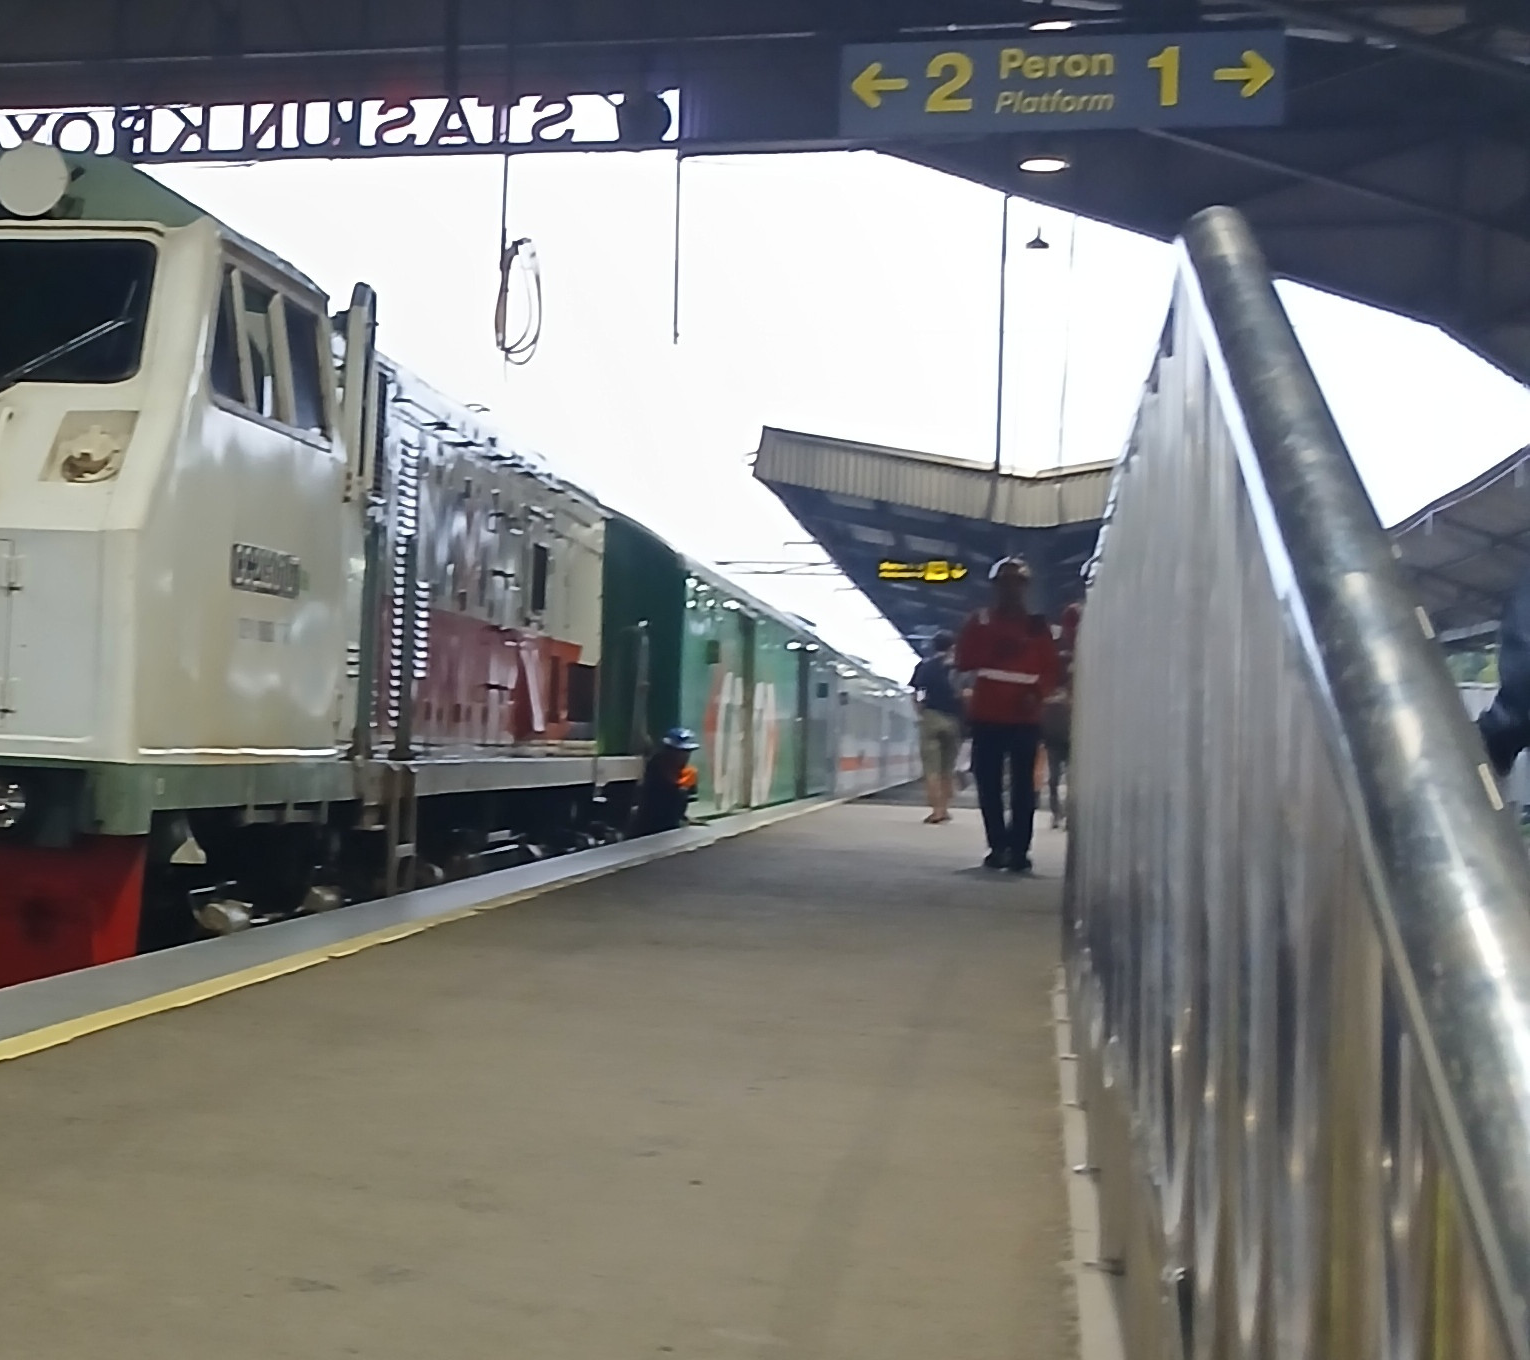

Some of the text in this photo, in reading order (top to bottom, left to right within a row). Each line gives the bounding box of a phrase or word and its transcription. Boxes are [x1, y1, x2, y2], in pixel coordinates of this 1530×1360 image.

[924, 51, 974, 113] 2
[999, 48, 1116, 80] Peron
[1147, 45, 1181, 107] 1
[994, 88, 1116, 115] Platform
